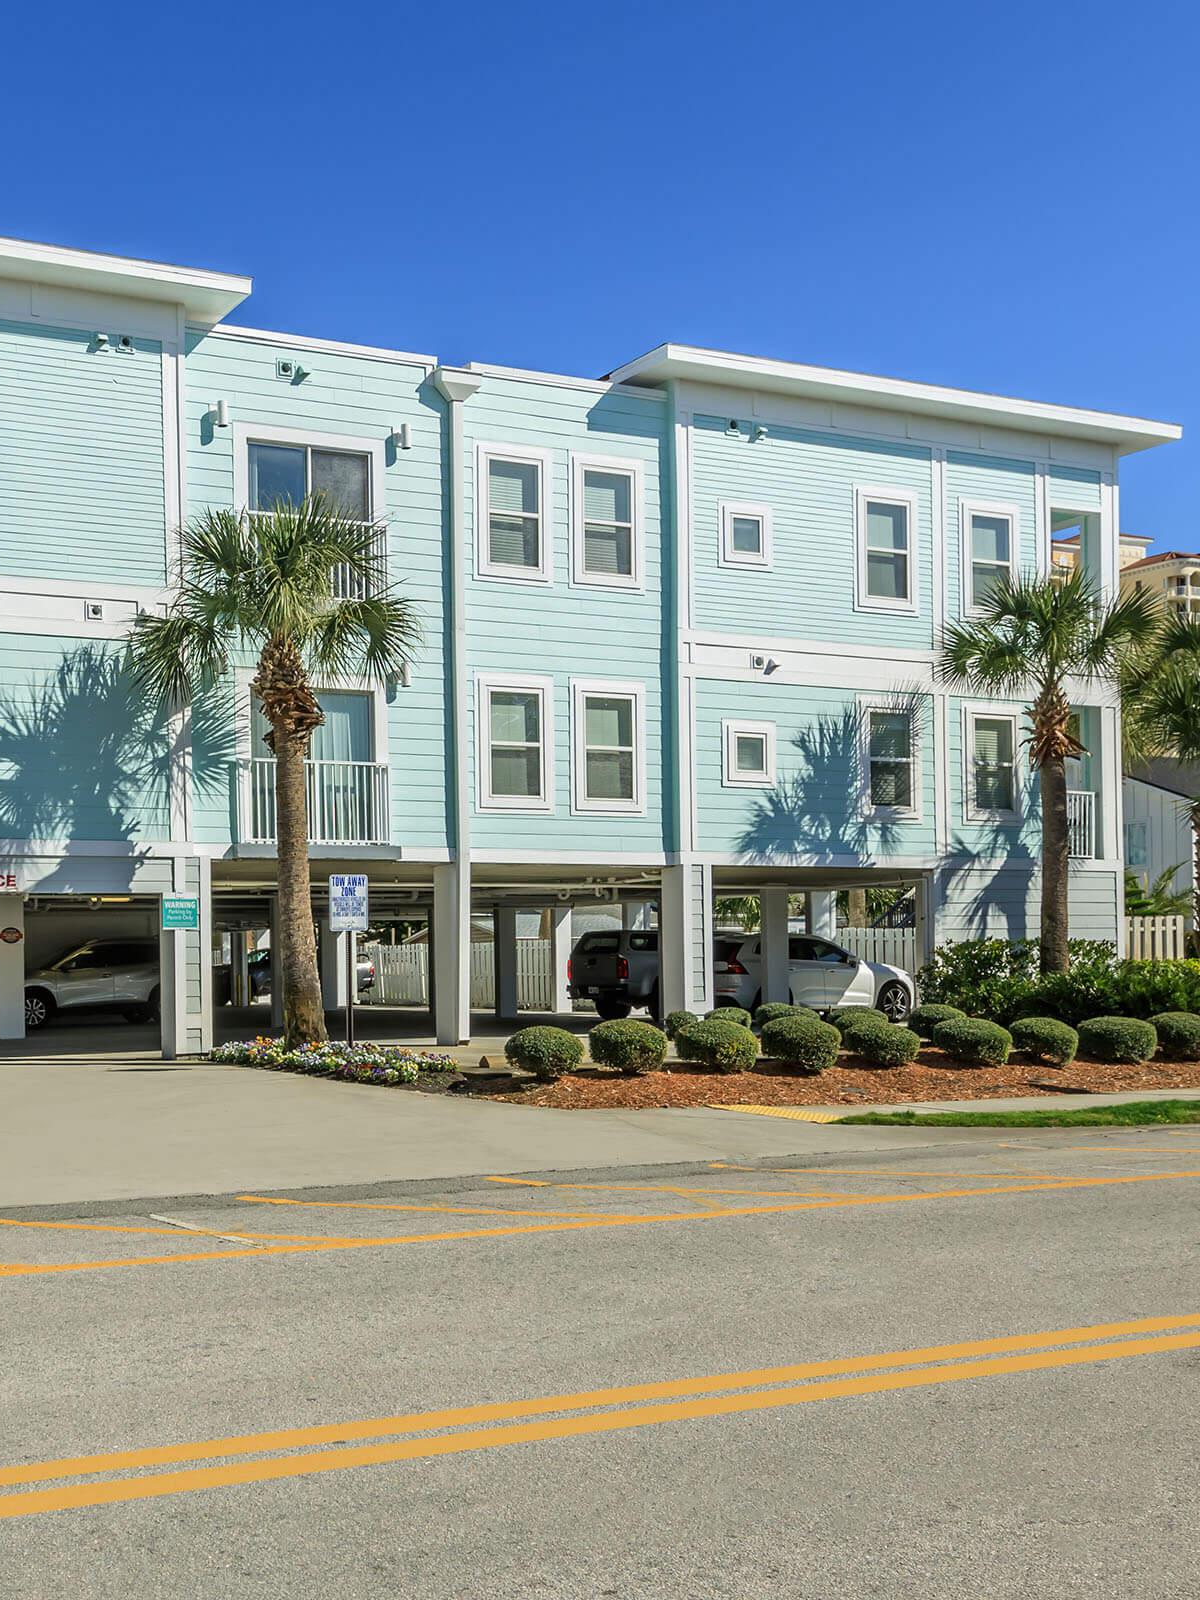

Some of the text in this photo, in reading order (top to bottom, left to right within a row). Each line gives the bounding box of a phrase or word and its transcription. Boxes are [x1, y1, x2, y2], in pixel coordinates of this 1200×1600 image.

[332, 876, 365, 887] TOW AWAY
[342, 887, 356, 896] ZONE
